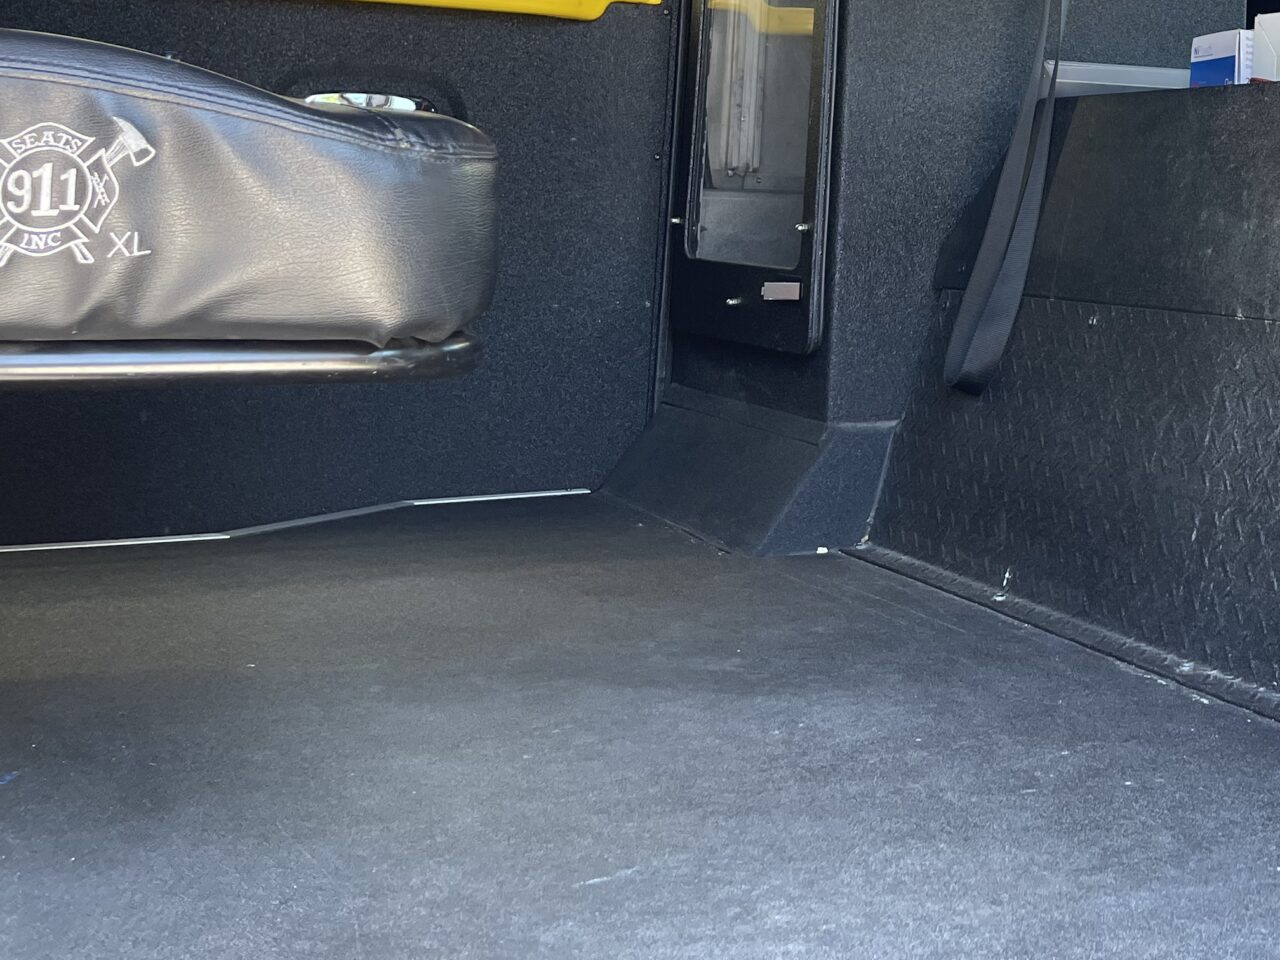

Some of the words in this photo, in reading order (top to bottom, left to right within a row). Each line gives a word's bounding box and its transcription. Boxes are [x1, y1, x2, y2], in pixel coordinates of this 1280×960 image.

[12, 131, 82, 153] SEATS
[6, 162, 80, 216] 911
[20, 232, 62, 249] INC
[107, 231, 151, 257] XL
